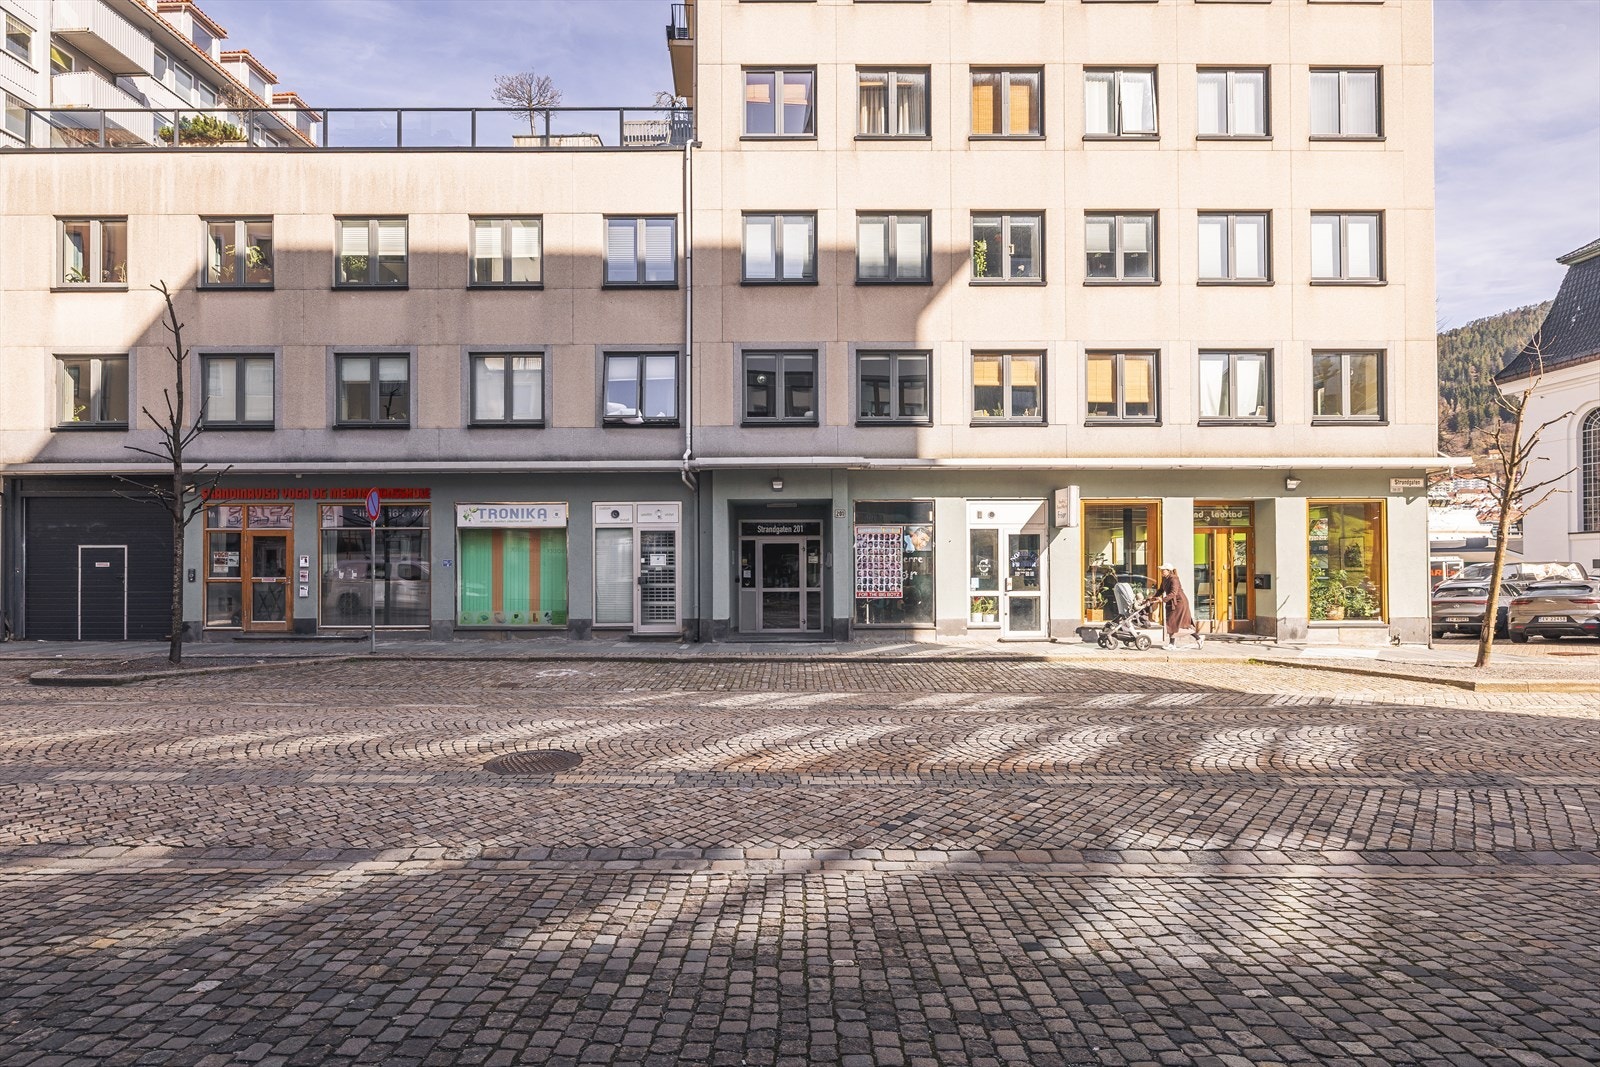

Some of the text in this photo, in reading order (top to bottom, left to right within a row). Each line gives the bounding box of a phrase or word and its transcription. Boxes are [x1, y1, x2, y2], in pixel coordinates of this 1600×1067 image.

[1394, 479, 1421, 487] Strandgaten
[281, 487, 311, 500] YOGA
[311, 487, 328, 500] OG
[329, 487, 432, 500] MEDITAONSSKOLE
[478, 507, 548, 520] TRONIKA
[757, 525, 804, 535] Strandgaten 201
